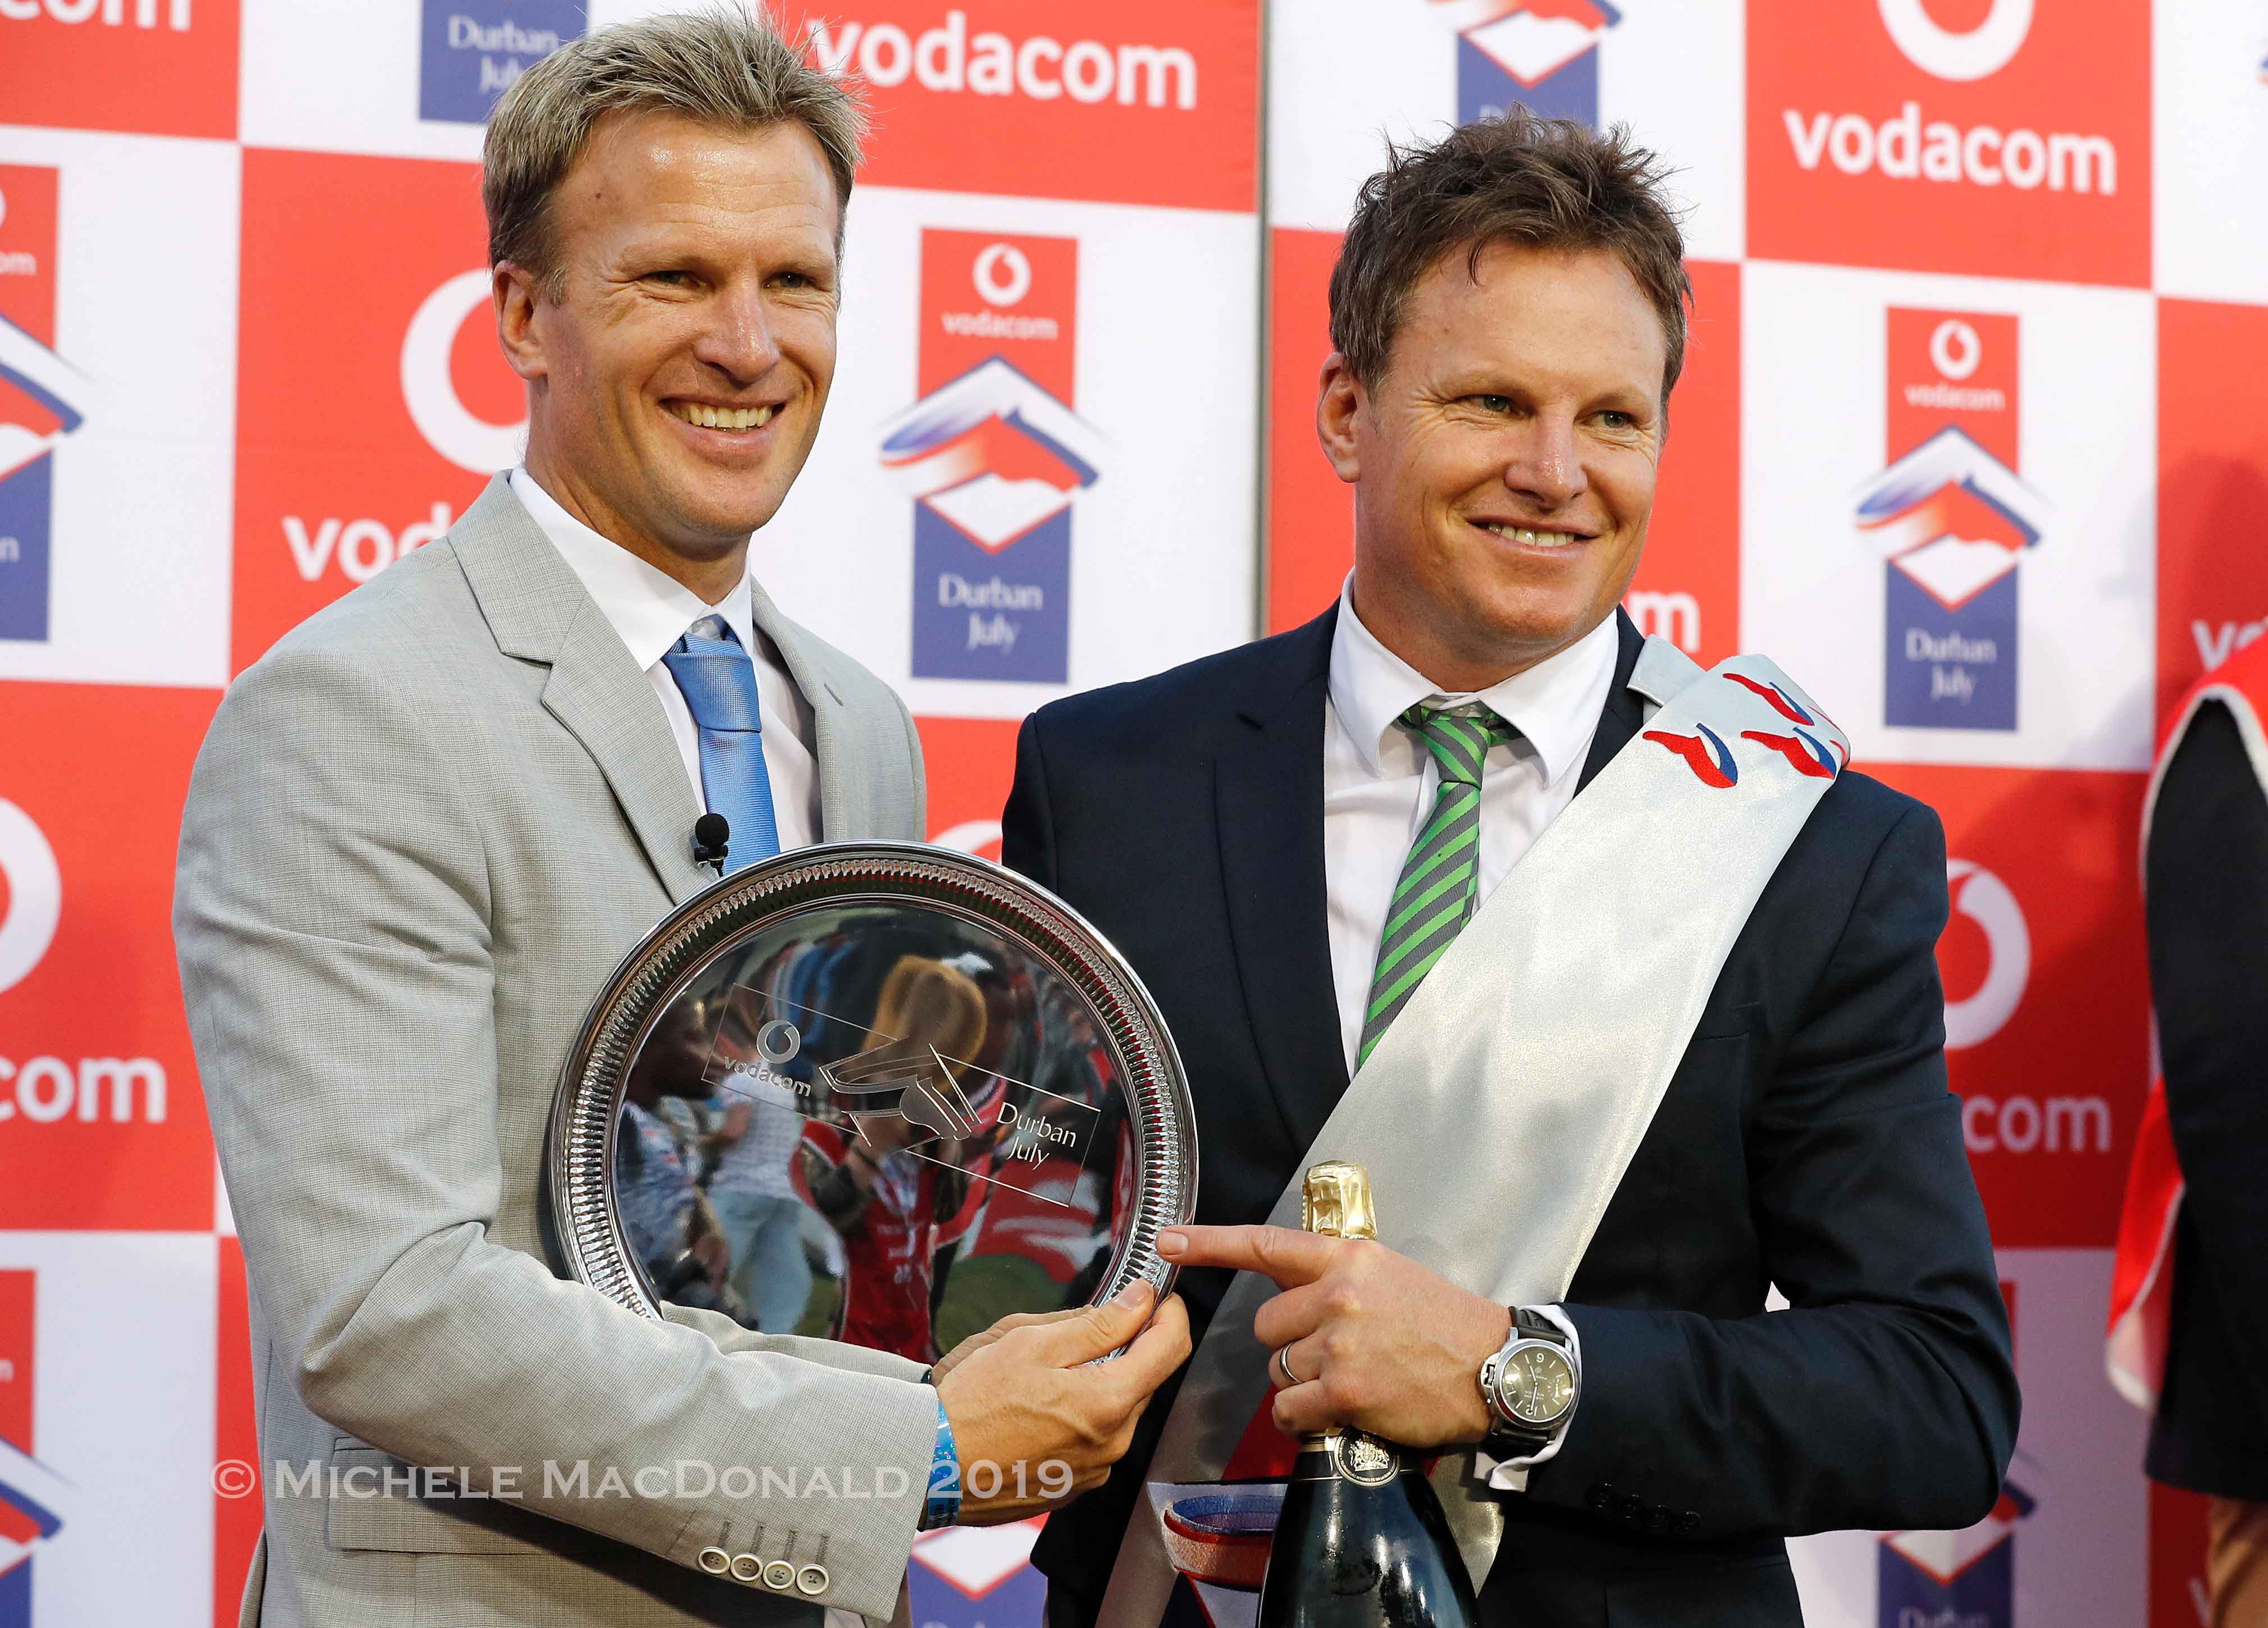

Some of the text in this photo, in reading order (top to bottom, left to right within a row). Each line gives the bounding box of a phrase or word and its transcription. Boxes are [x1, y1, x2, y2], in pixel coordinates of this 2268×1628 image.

[448, 15, 558, 54] Durban
[805, 10, 1198, 109] vodacom
[1782, 101, 2117, 195] vodacom
[941, 310, 1059, 340] vodacom
[1904, 383, 2006, 410] vodacom
[938, 573, 1044, 610] Durban
[965, 612, 1018, 652] July
[1905, 627, 1997, 663] Durban
[1930, 666, 1974, 702] July
[724, 1055, 811, 1097] vodacom
[997, 1101, 1076, 1147] Durban
[1006, 1136, 1050, 1170] July
